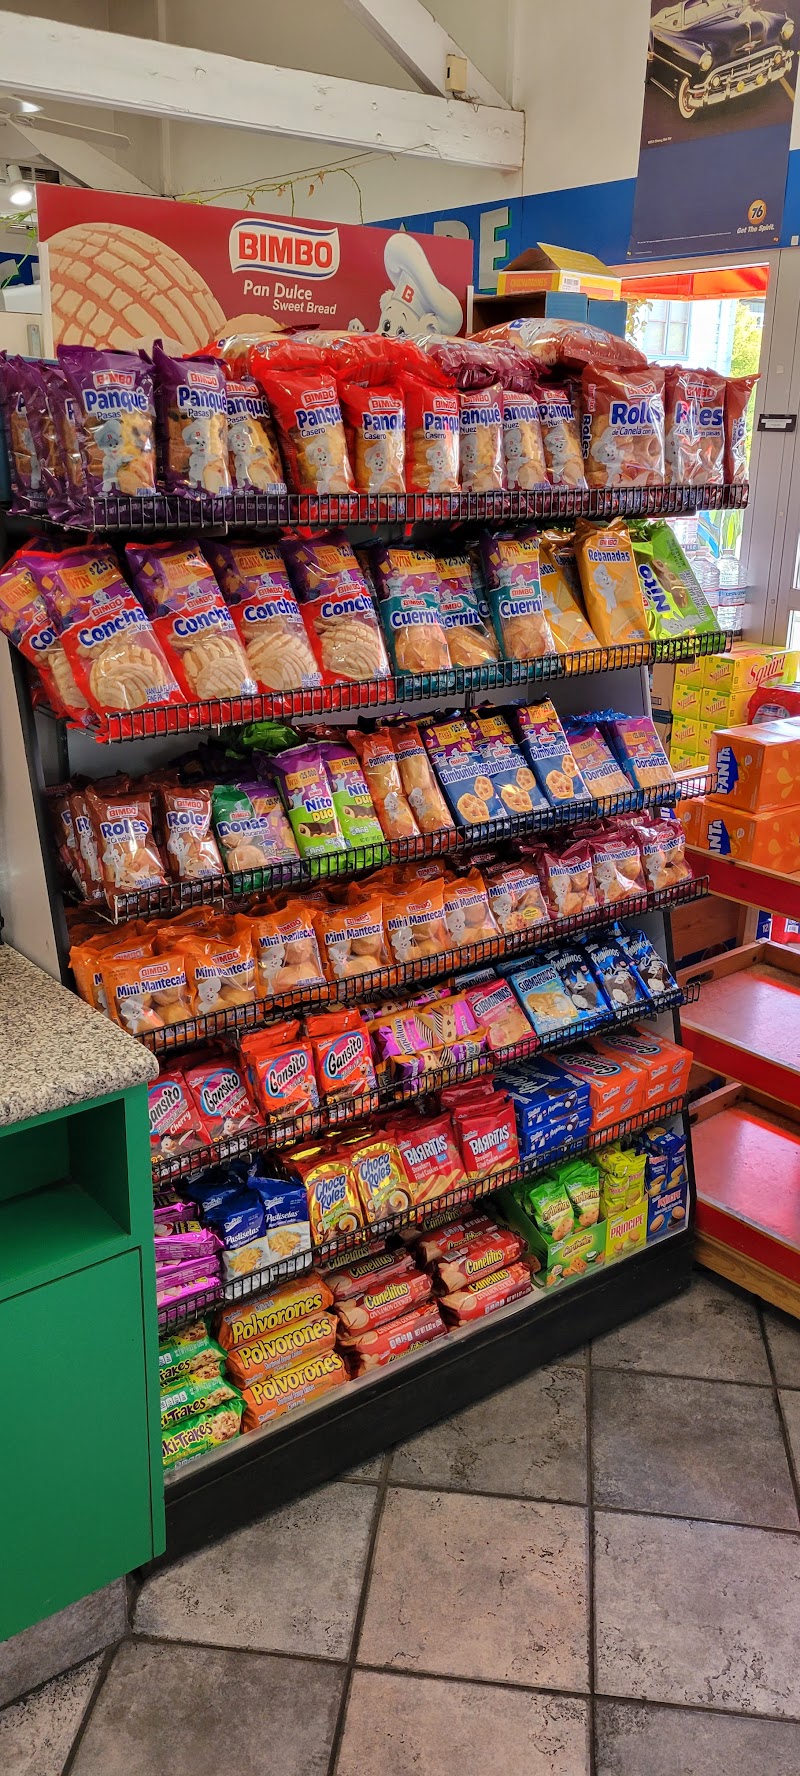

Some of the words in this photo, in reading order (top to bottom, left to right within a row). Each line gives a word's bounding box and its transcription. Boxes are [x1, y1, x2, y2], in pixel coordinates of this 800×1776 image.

[751, 205, 764, 219] 76
[748, 225, 757, 234] The
[239, 231, 333, 269] BIMBO
[243, 279, 269, 297] Pan
[274, 282, 312, 300] Dulce
[272, 299, 304, 313] Sweet
[306, 302, 337, 315] Bread
[190, 373, 218, 387] BIMBO
[85, 388, 149, 413] Panqué
[178, 387, 227, 413] Panqué
[303, 391, 335, 402] BIMBO
[435, 400, 457, 410] BIMBO
[463, 393, 490, 403] BIMBO
[97, 411, 122, 420] Pasas
[188, 408, 210, 418] Pasas
[226, 397, 270, 417] anqué
[538, 404, 574, 421] Panqu
[295, 407, 342, 429] Panqu
[423, 413, 459, 432] Panqu
[301, 427, 326, 437] Casero
[364, 432, 387, 440] Casero
[425, 432, 447, 440] Casero
[460, 426, 477, 434] Nuez
[581, 415, 592, 459] Roles
[619, 426, 642, 436] Canela
[503, 545, 520, 557] WIN
[588, 549, 631, 563] Rebanadas
[394, 554, 412, 568] WIN
[70, 574, 93, 591] WIN
[337, 585, 361, 594] BIMBO
[258, 587, 284, 597] BIMBO
[511, 588, 534, 597] BIMBO
[92, 600, 124, 616] BIMBO
[187, 595, 214, 608] BIMBO
[501, 599, 542, 616] Cuerni
[174, 605, 232, 637] Concha
[709, 663, 731, 681] Squirt
[747, 654, 786, 686] Squirt
[676, 691, 697, 709] Squirt
[705, 697, 727, 715] Squirt
[674, 724, 696, 741] Squirt
[635, 756, 669, 769] Doraditas
[716, 747, 731, 795] FANTA
[109, 807, 137, 817] BIMBO
[176, 800, 202, 809] BIMBO
[305, 797, 333, 812] Nito
[312, 809, 334, 822] DUO
[101, 819, 148, 838] Roles
[217, 817, 269, 837] Donas
[593, 853, 611, 864] Mini
[503, 870, 524, 879] BIMBO
[489, 886, 507, 897] Mini
[507, 875, 540, 891] Mantecada
[346, 914, 370, 925] BIMBO
[388, 917, 409, 931] Mini
[258, 934, 280, 948] Mini
[325, 932, 345, 945] Mini
[141, 964, 169, 977] BIMBO
[195, 966, 216, 979] Mini
[117, 984, 140, 998] Mini
[141, 974, 187, 993] Mantecad
[517, 966, 558, 993] SUBMARINOS
[473, 985, 512, 1017] SUBMARINOS
[603, 1034, 660, 1055] Gansito
[327, 1035, 363, 1076] Gansito
[559, 1053, 617, 1076] Gansito
[268, 1053, 307, 1095] Gansito
[203, 1073, 239, 1113] Gansito
[150, 1085, 182, 1123] ansito
[230, 1097, 249, 1117] Cherry
[170, 1111, 192, 1135] Cherry
[360, 1152, 390, 1181] Choco
[315, 1174, 347, 1199] Choco
[367, 1164, 392, 1193] Roles
[321, 1187, 347, 1214] Roles
[265, 1210, 299, 1223] Pastisetas
[349, 1253, 393, 1278] Canelitas
[465, 1248, 505, 1275] Canelitas
[468, 1269, 510, 1292] Canelitas
[364, 1282, 410, 1310] Canelitas
[232, 1293, 323, 1344] Polvorones
[237, 1317, 332, 1369] Polvorones
[249, 1352, 343, 1406] Polvorones
